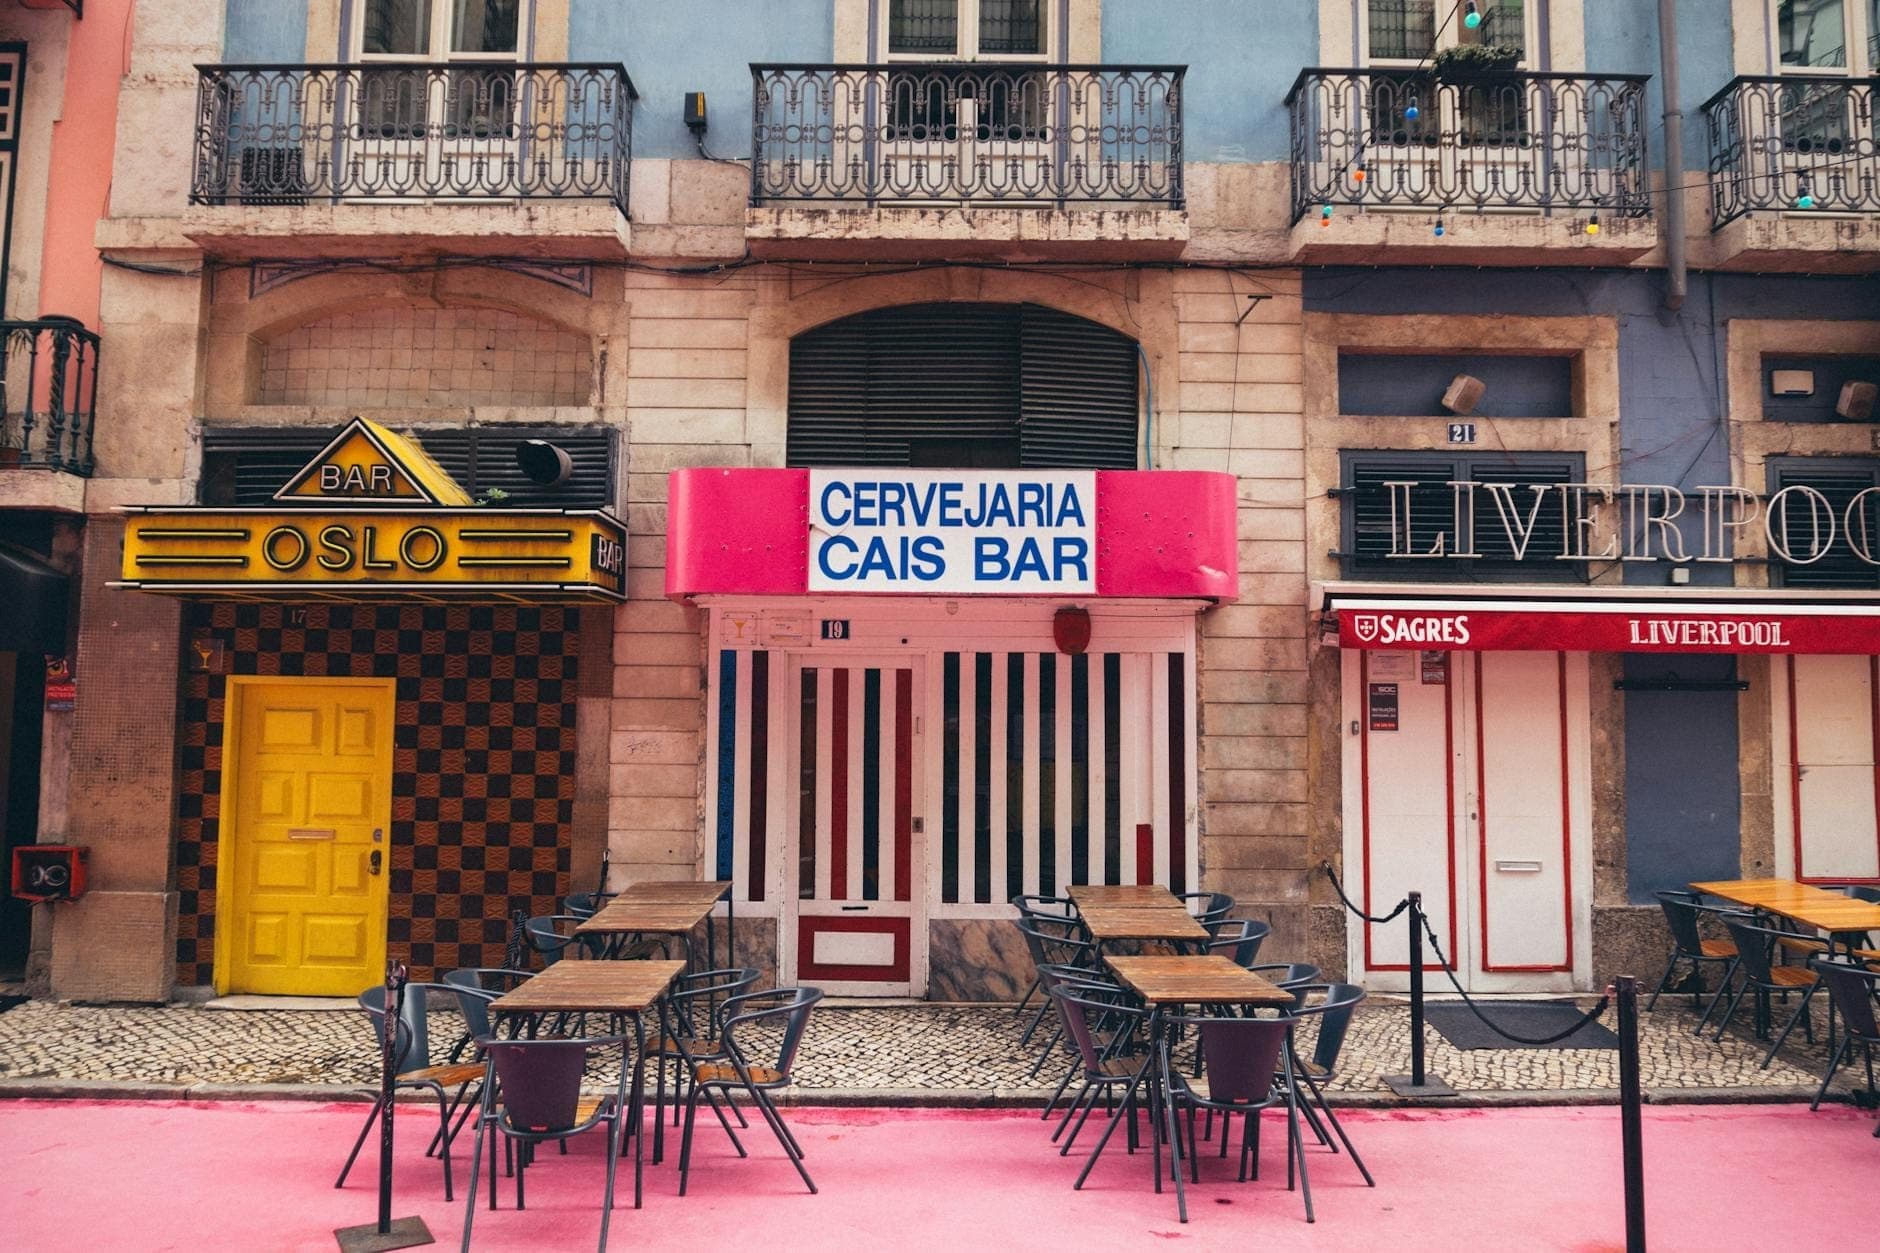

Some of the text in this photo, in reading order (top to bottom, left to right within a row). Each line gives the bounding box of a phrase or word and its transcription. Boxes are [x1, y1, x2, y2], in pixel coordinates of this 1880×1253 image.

[1453, 425, 1471, 442] 21
[320, 465, 392, 491] BAR
[820, 481, 1085, 528] CERVEJARIA
[263, 526, 446, 571] OSLO
[597, 535, 623, 575] BAR
[818, 536, 1089, 581] CAIS BAR
[290, 609, 307, 624] 17
[828, 620, 843, 639] 19
[1380, 614, 1470, 645] SAGRES
[1629, 619, 1790, 646] LIVERPOOL
